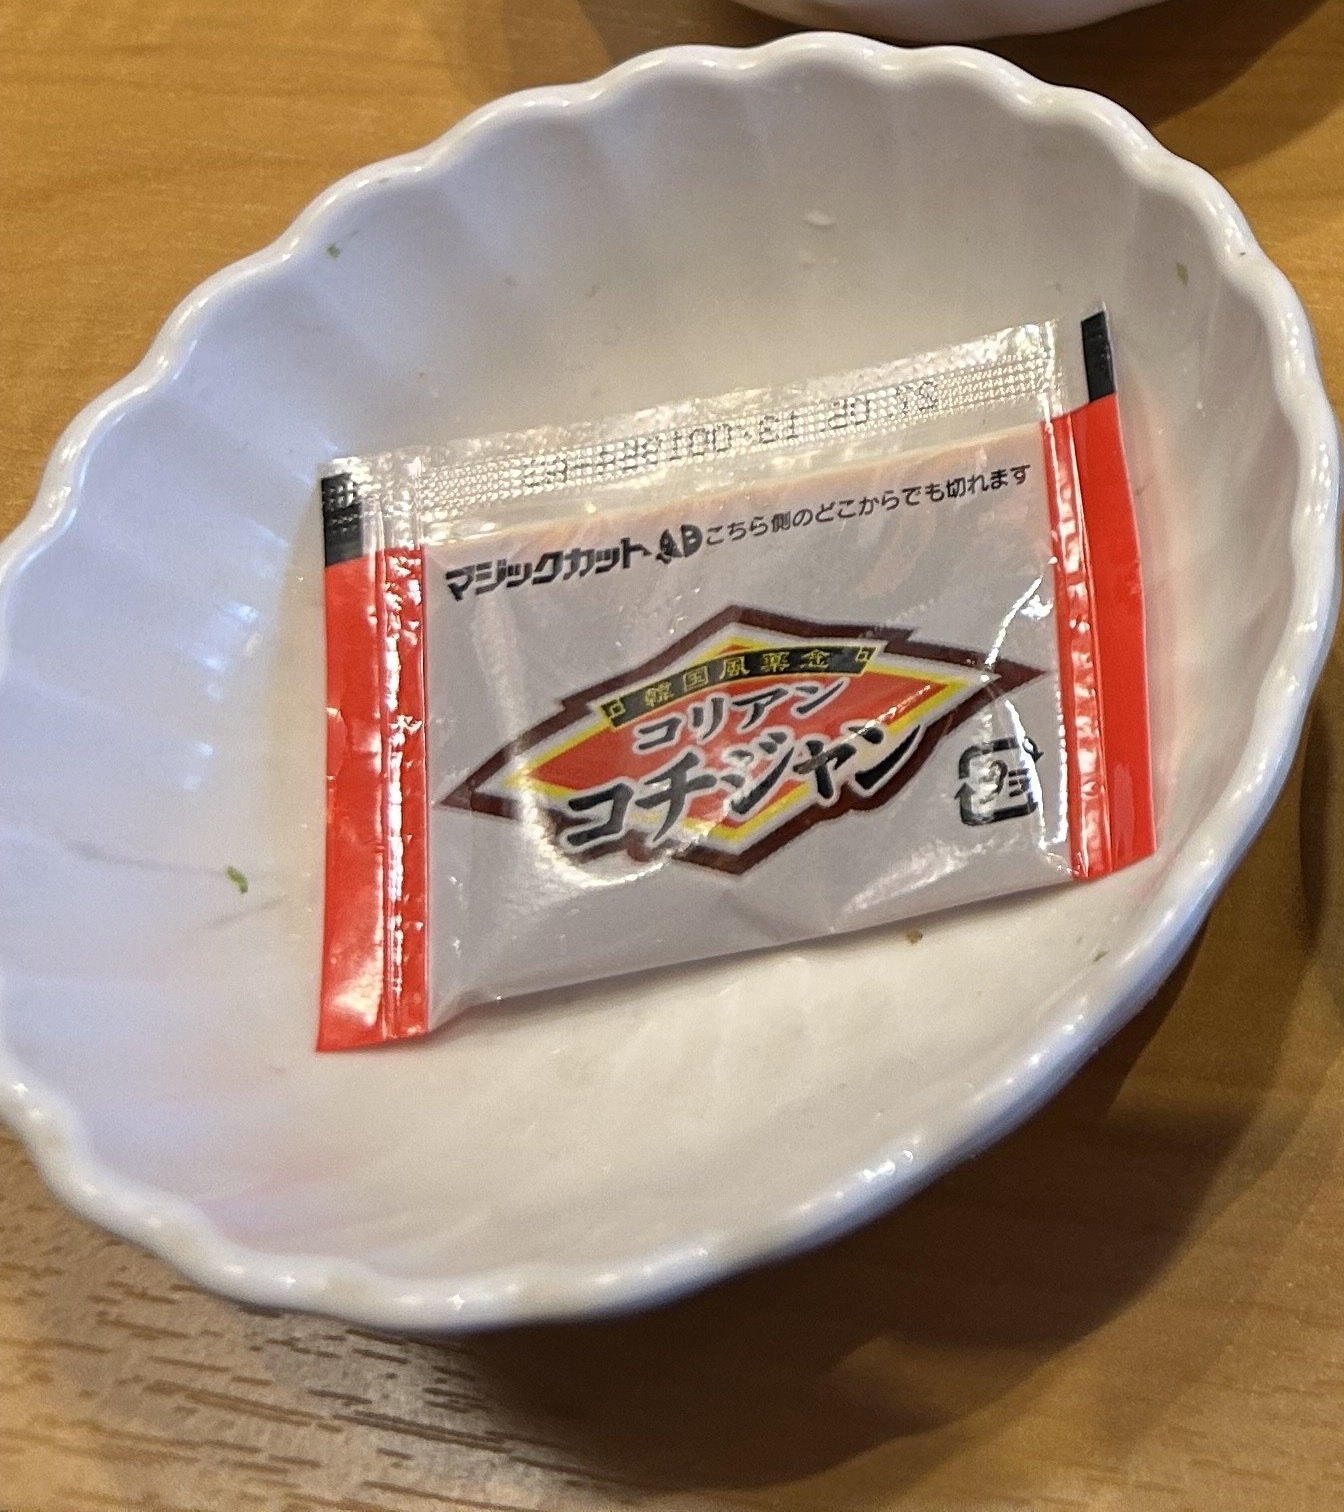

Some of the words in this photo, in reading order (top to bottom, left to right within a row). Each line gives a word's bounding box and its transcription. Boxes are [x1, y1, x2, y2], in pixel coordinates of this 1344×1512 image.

[445, 535, 655, 600] マジックカット
[704, 462, 1034, 548] こちら側のどこからでも切れます
[635, 676, 846, 751] コリアン
[566, 725, 922, 847] コチジャン
